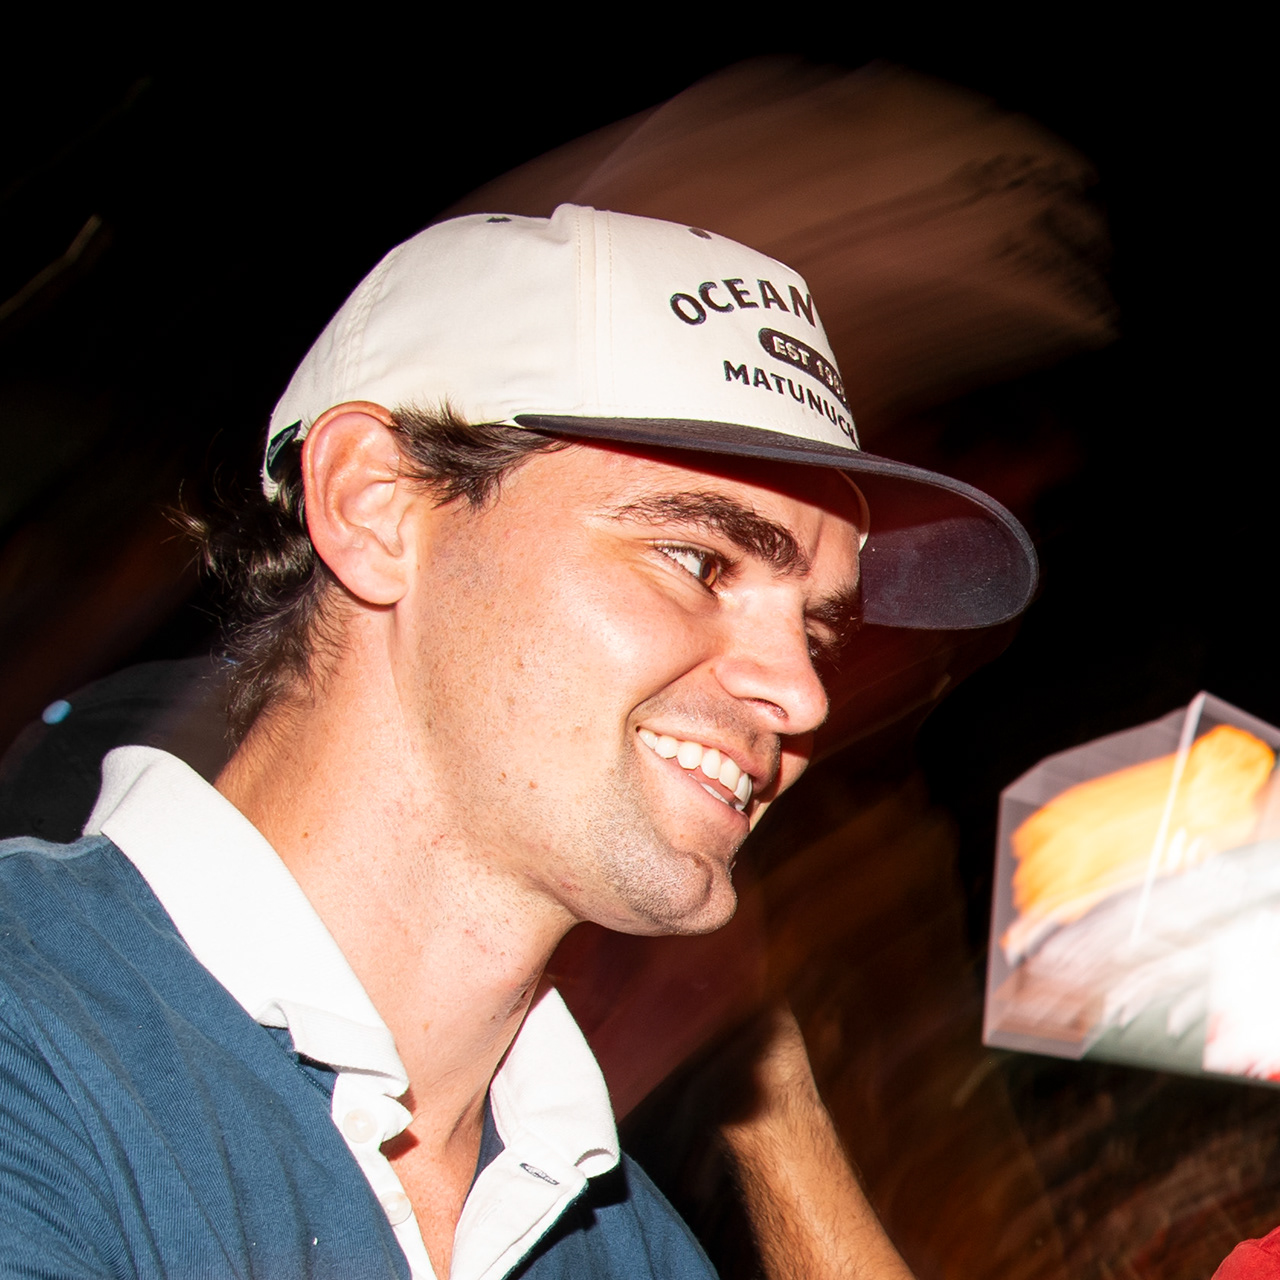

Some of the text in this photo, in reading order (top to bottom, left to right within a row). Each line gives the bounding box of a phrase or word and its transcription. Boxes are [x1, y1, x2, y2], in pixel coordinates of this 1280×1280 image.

[669, 278, 817, 328] OCEAN
[771, 335, 811, 366] EST
[723, 360, 860, 446] MATUNUCK
